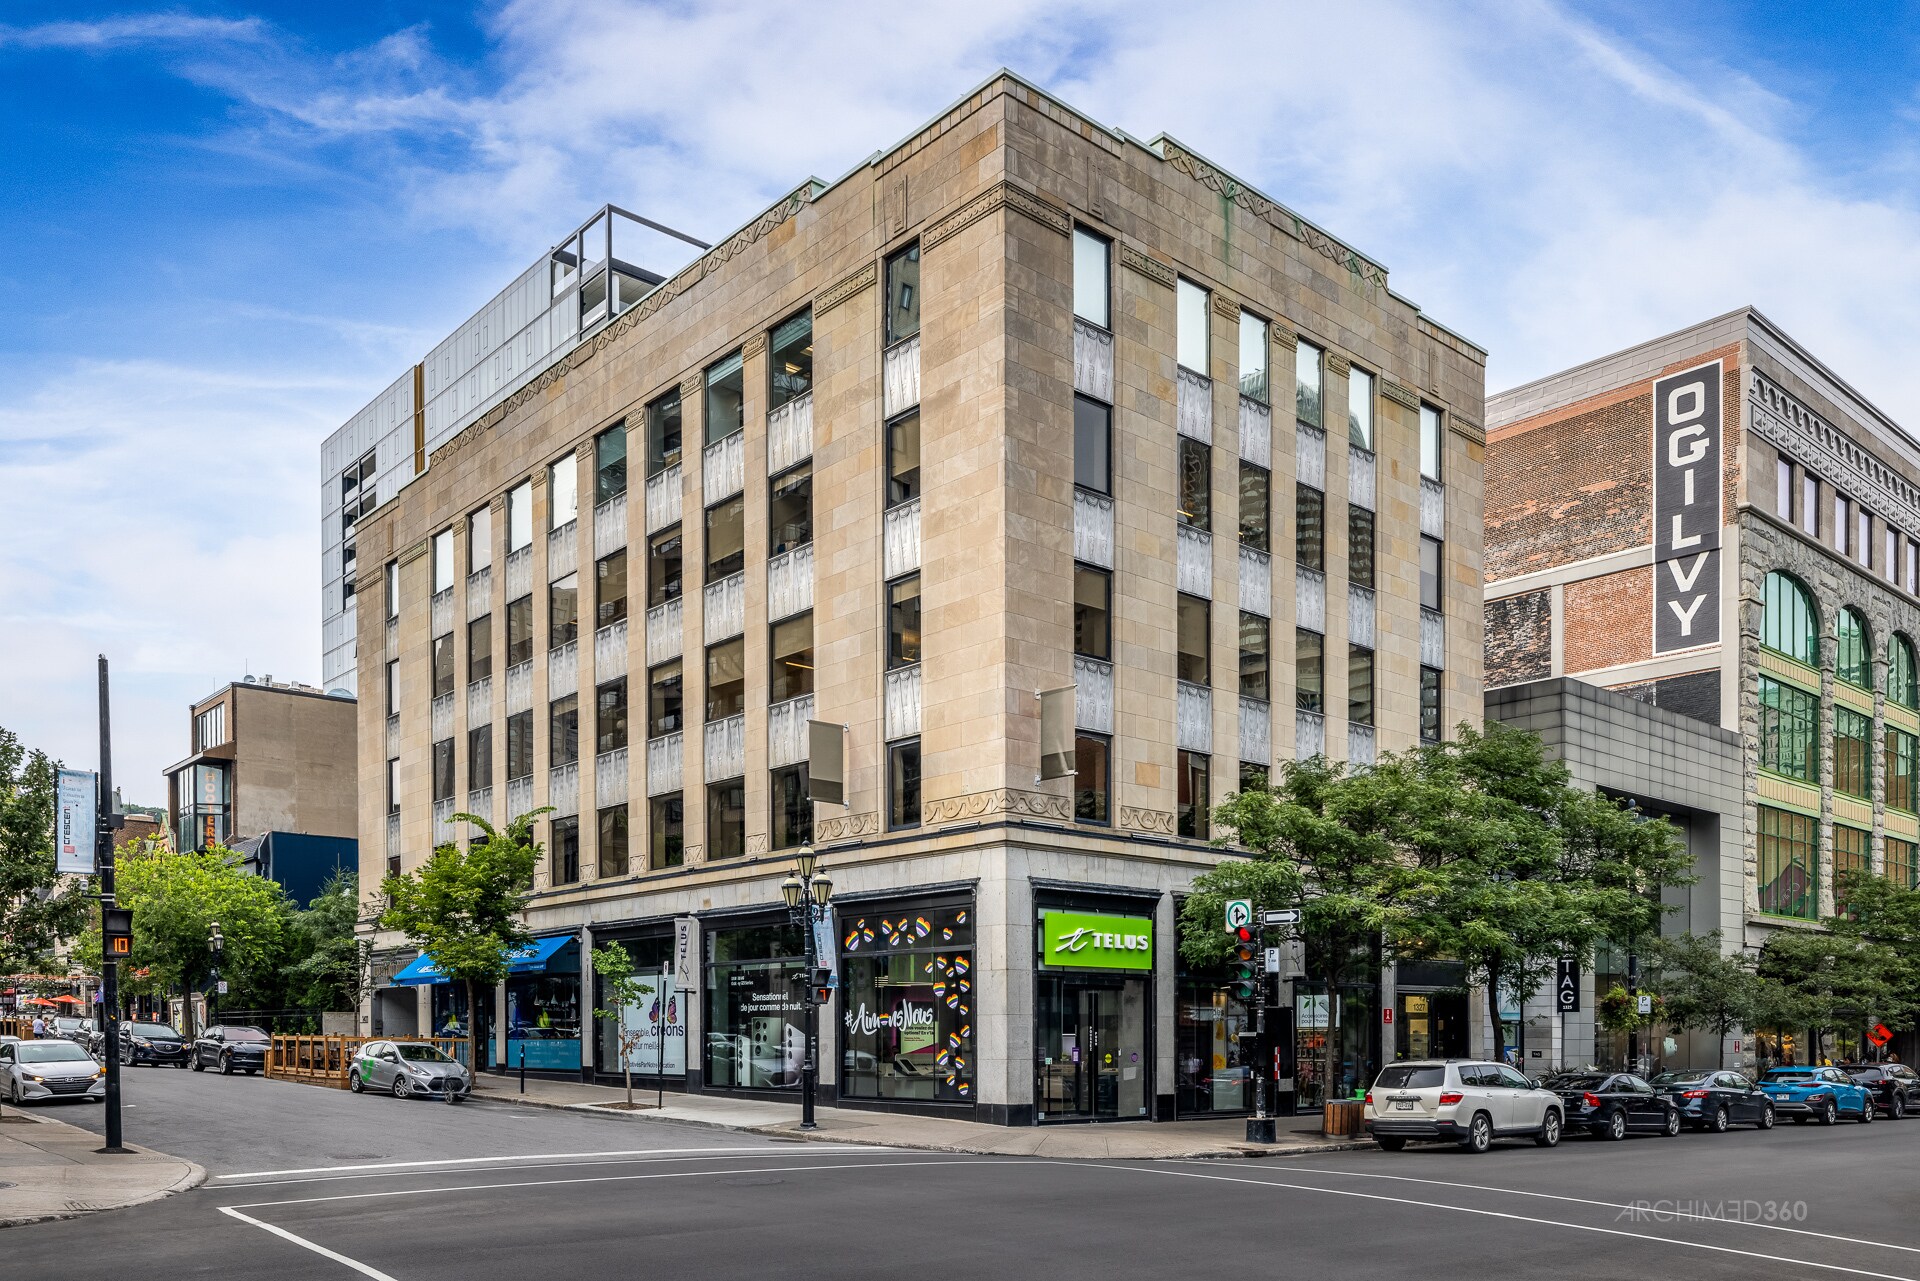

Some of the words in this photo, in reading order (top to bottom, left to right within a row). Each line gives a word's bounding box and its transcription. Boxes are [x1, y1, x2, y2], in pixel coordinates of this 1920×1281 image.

[1667, 381, 1710, 637] OGILVY
[114, 937, 128, 953] 10
[1092, 933, 1149, 950] TELUS
[1269, 949, 1274, 959] P
[1560, 959, 1574, 1004] TAG
[1413, 1003, 1425, 1012] 1327
